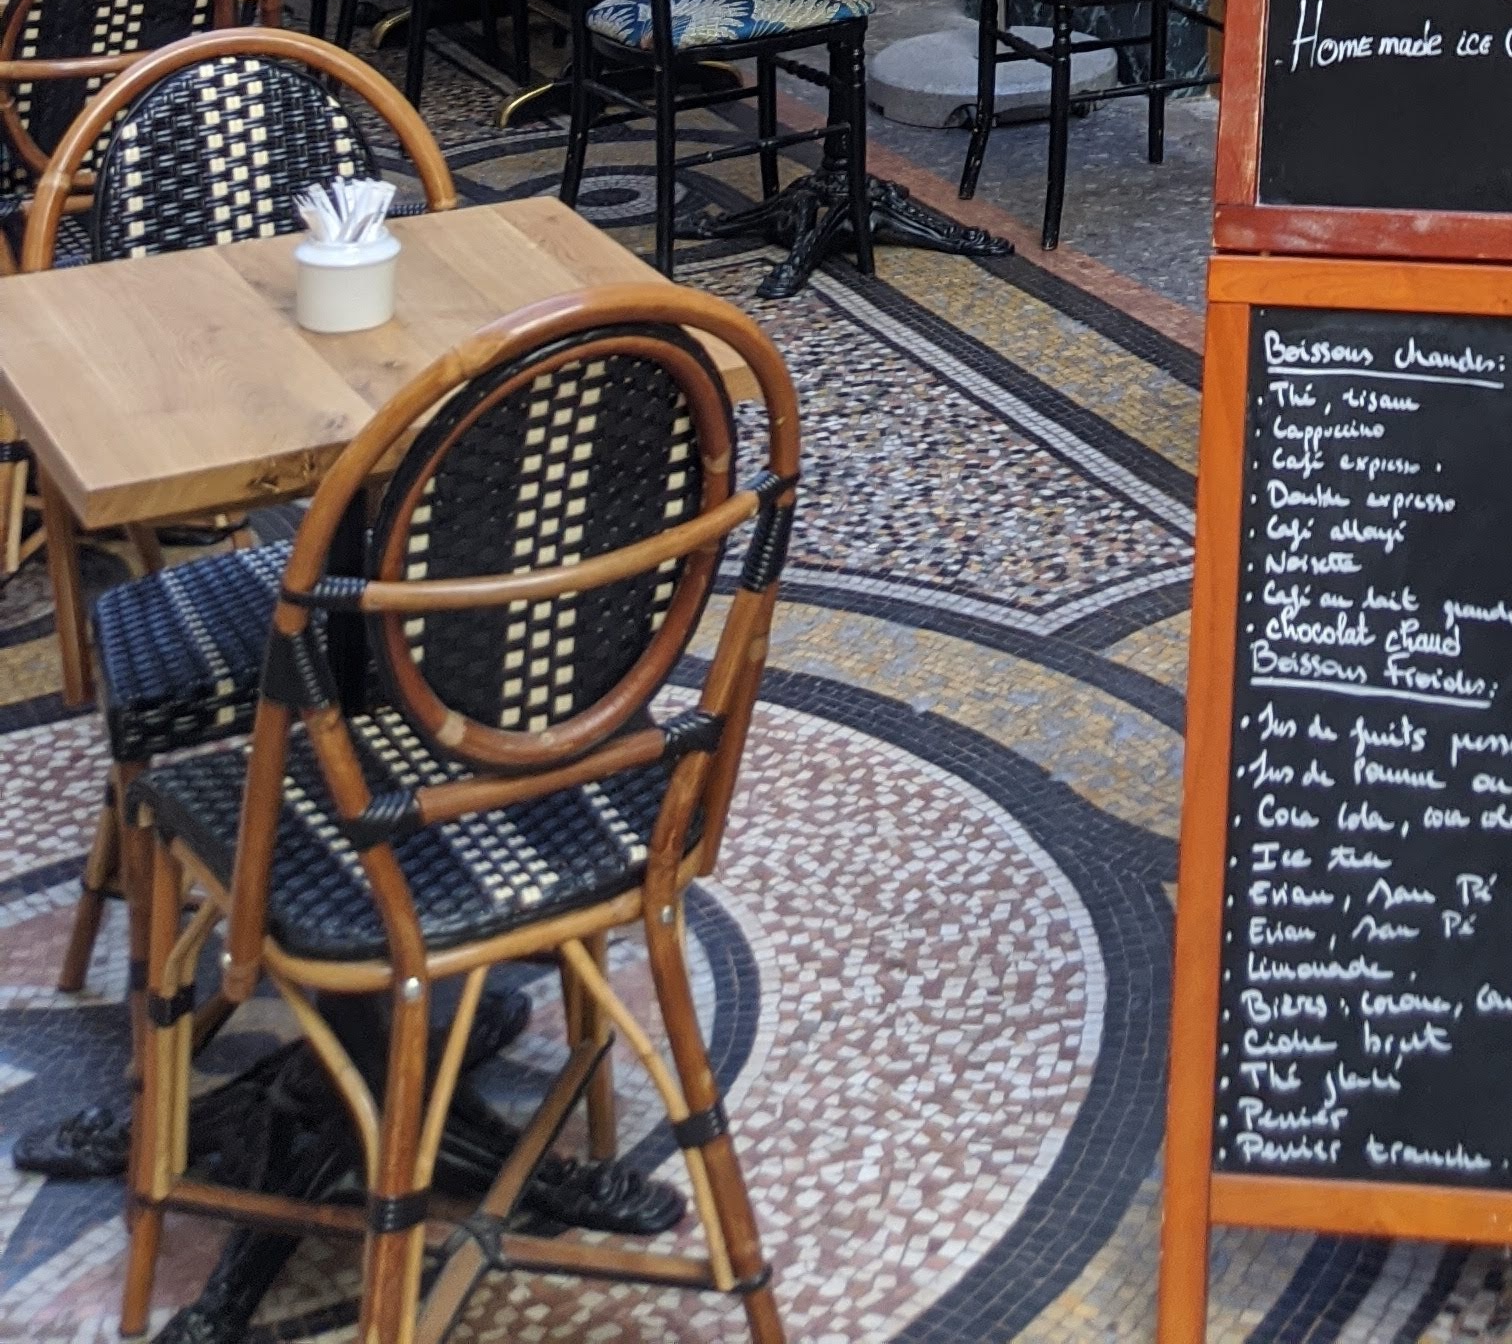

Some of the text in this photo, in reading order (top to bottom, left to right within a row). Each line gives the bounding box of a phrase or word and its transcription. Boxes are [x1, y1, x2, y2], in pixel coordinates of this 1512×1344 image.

[1264, 330, 1374, 365] Boissons
[1272, 416, 1386, 450] Cappuccino
[1272, 446, 1325, 479] Café
[1366, 490, 1457, 519] expresso
[1266, 513, 1315, 552] Café
[1265, 550, 1363, 576] Noisette
[1263, 580, 1312, 616] Café
[1320, 592, 1354, 609] au
[1362, 585, 1421, 612] lait
[1250, 639, 1368, 685] Boissons
[1258, 701, 1297, 741] Jus
[1308, 713, 1339, 741] de
[1349, 714, 1428, 757] fruits
[1247, 748, 1294, 789] Jus
[1301, 757, 1336, 789] de
[1258, 792, 1320, 830] Coca
[1251, 840, 1313, 872] Ice
[1363, 1020, 1453, 1058] brut
[1239, 1061, 1302, 1091] Thé
